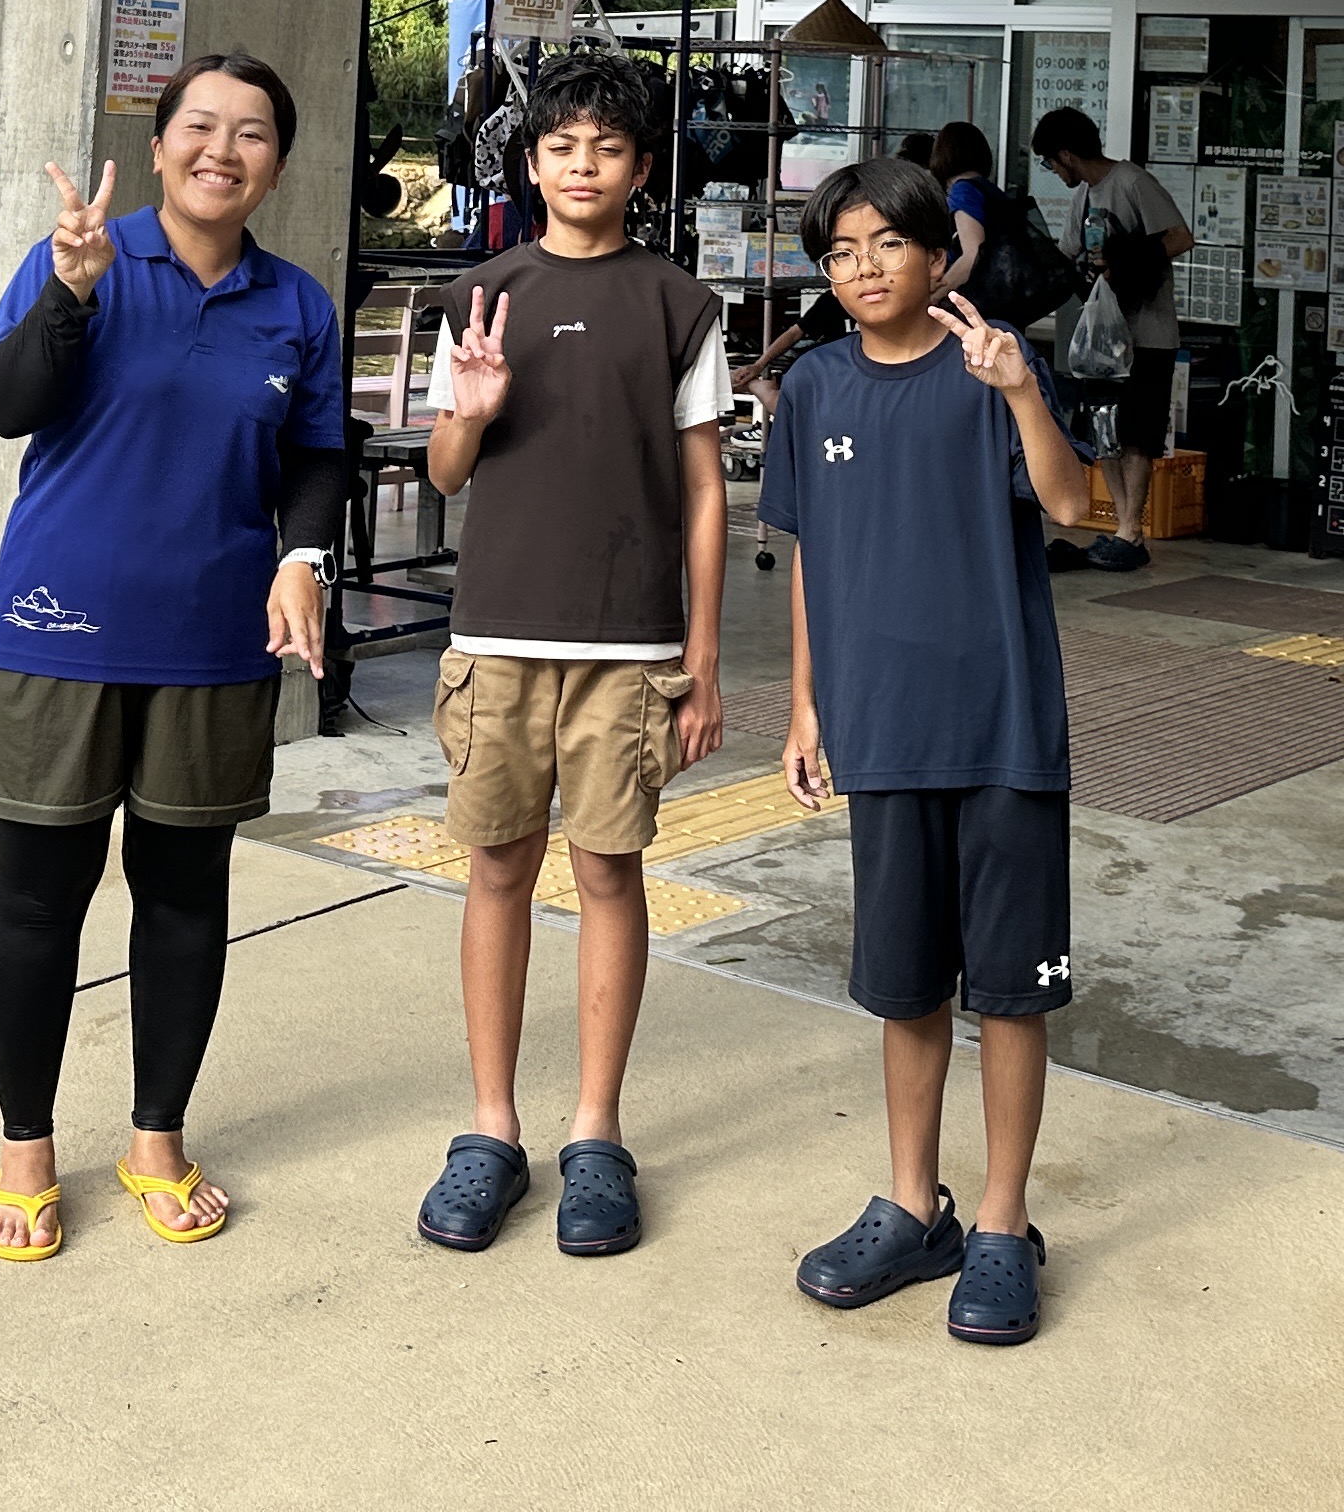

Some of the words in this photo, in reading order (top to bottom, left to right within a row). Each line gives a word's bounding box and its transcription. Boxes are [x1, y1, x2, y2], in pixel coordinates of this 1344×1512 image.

[1320, 445, 1329, 457] 3
[1318, 474, 1327, 487] 2
[1317, 504, 1323, 516] 1
